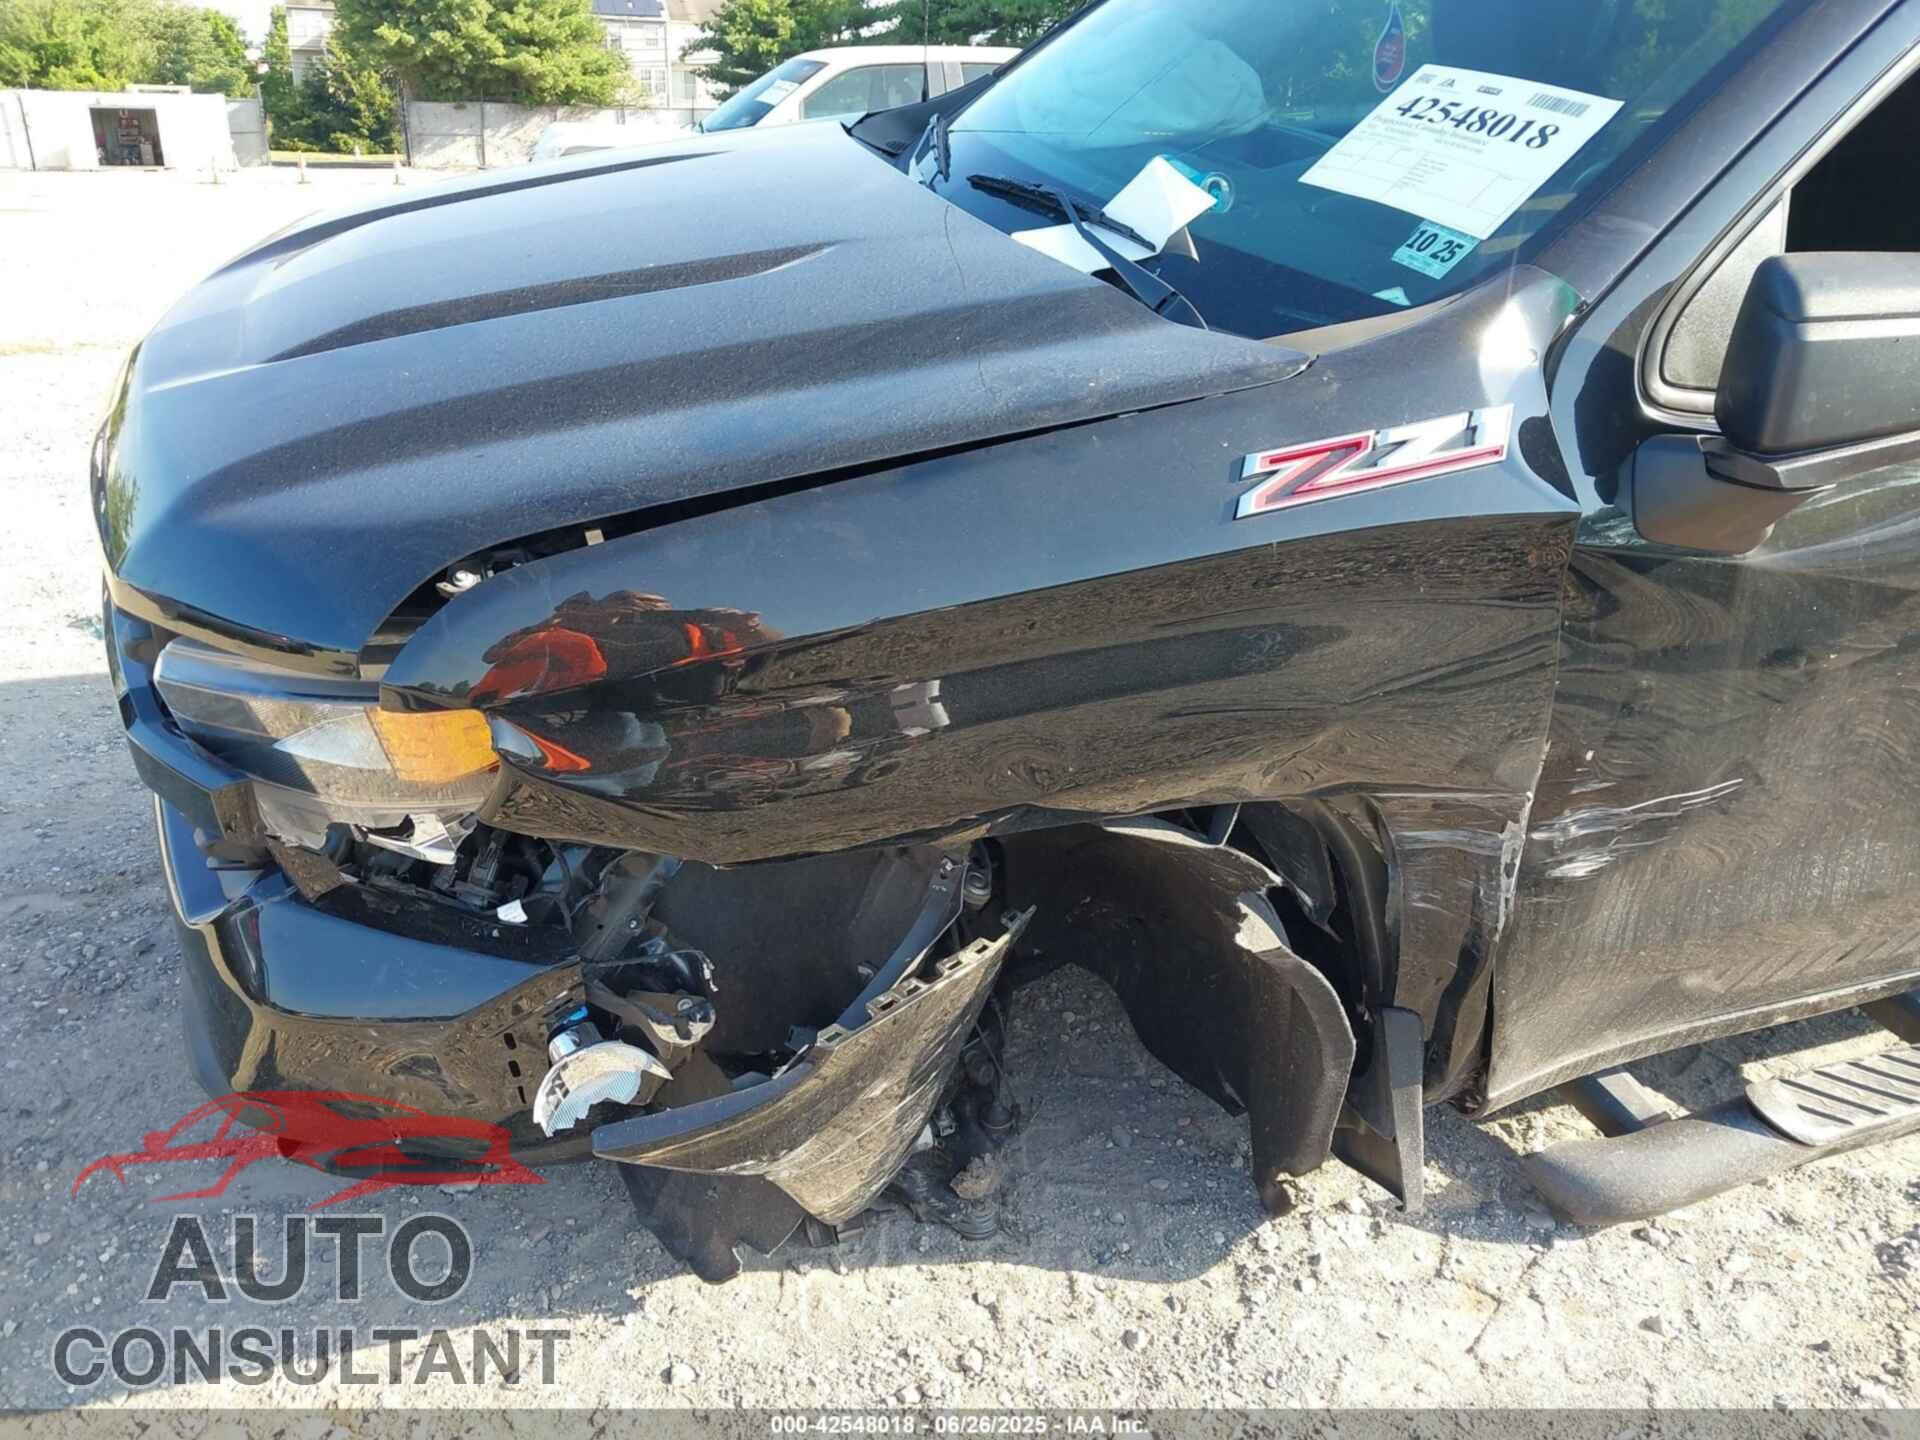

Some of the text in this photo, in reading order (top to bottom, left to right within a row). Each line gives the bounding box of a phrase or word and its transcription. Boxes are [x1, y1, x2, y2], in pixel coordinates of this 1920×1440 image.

[1396, 95, 1561, 150] 42548018
[1405, 229, 1439, 253] 10
[1430, 239, 1465, 263] 25
[1233, 403, 1514, 520] Z71
